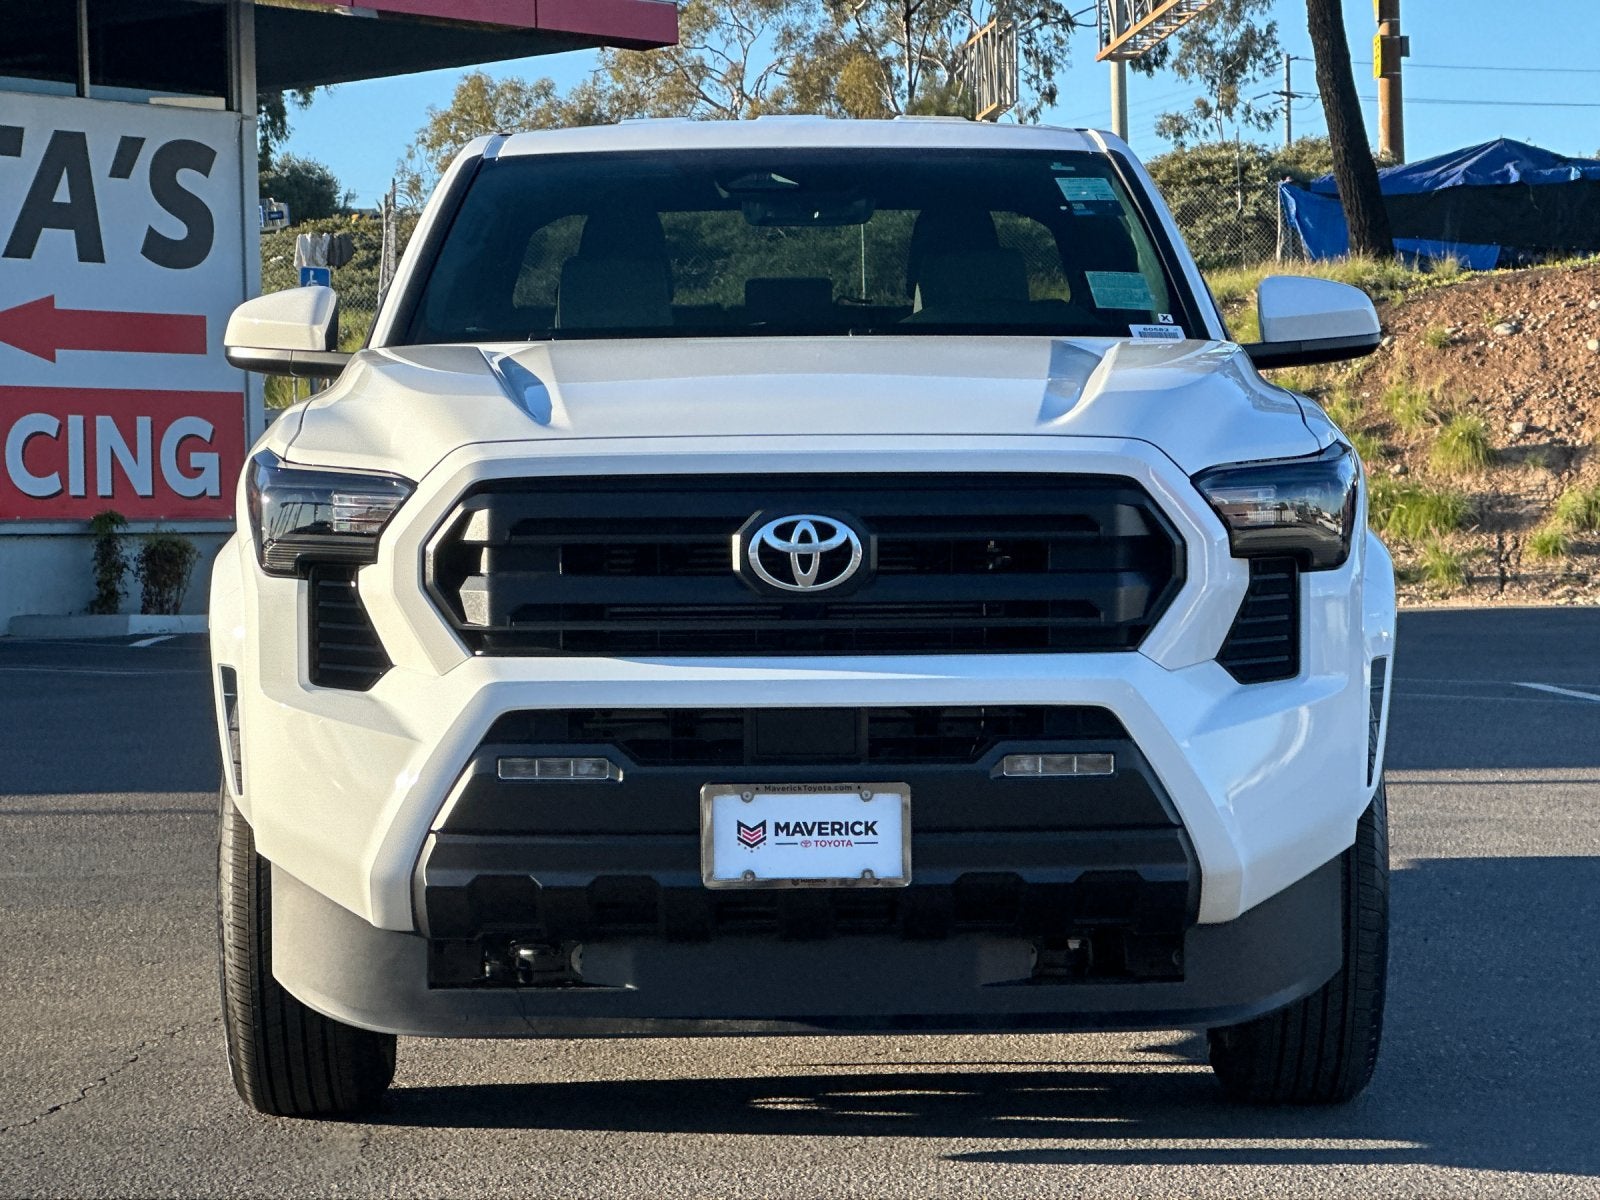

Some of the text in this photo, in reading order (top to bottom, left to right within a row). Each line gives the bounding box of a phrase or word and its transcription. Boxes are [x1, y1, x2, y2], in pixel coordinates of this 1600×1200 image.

[1161, 314, 1171, 322] X
[764, 784, 853, 792] MaverickToyota.com
[774, 820, 878, 836] MAVERICK
[813, 839, 853, 848] TOYOTA
